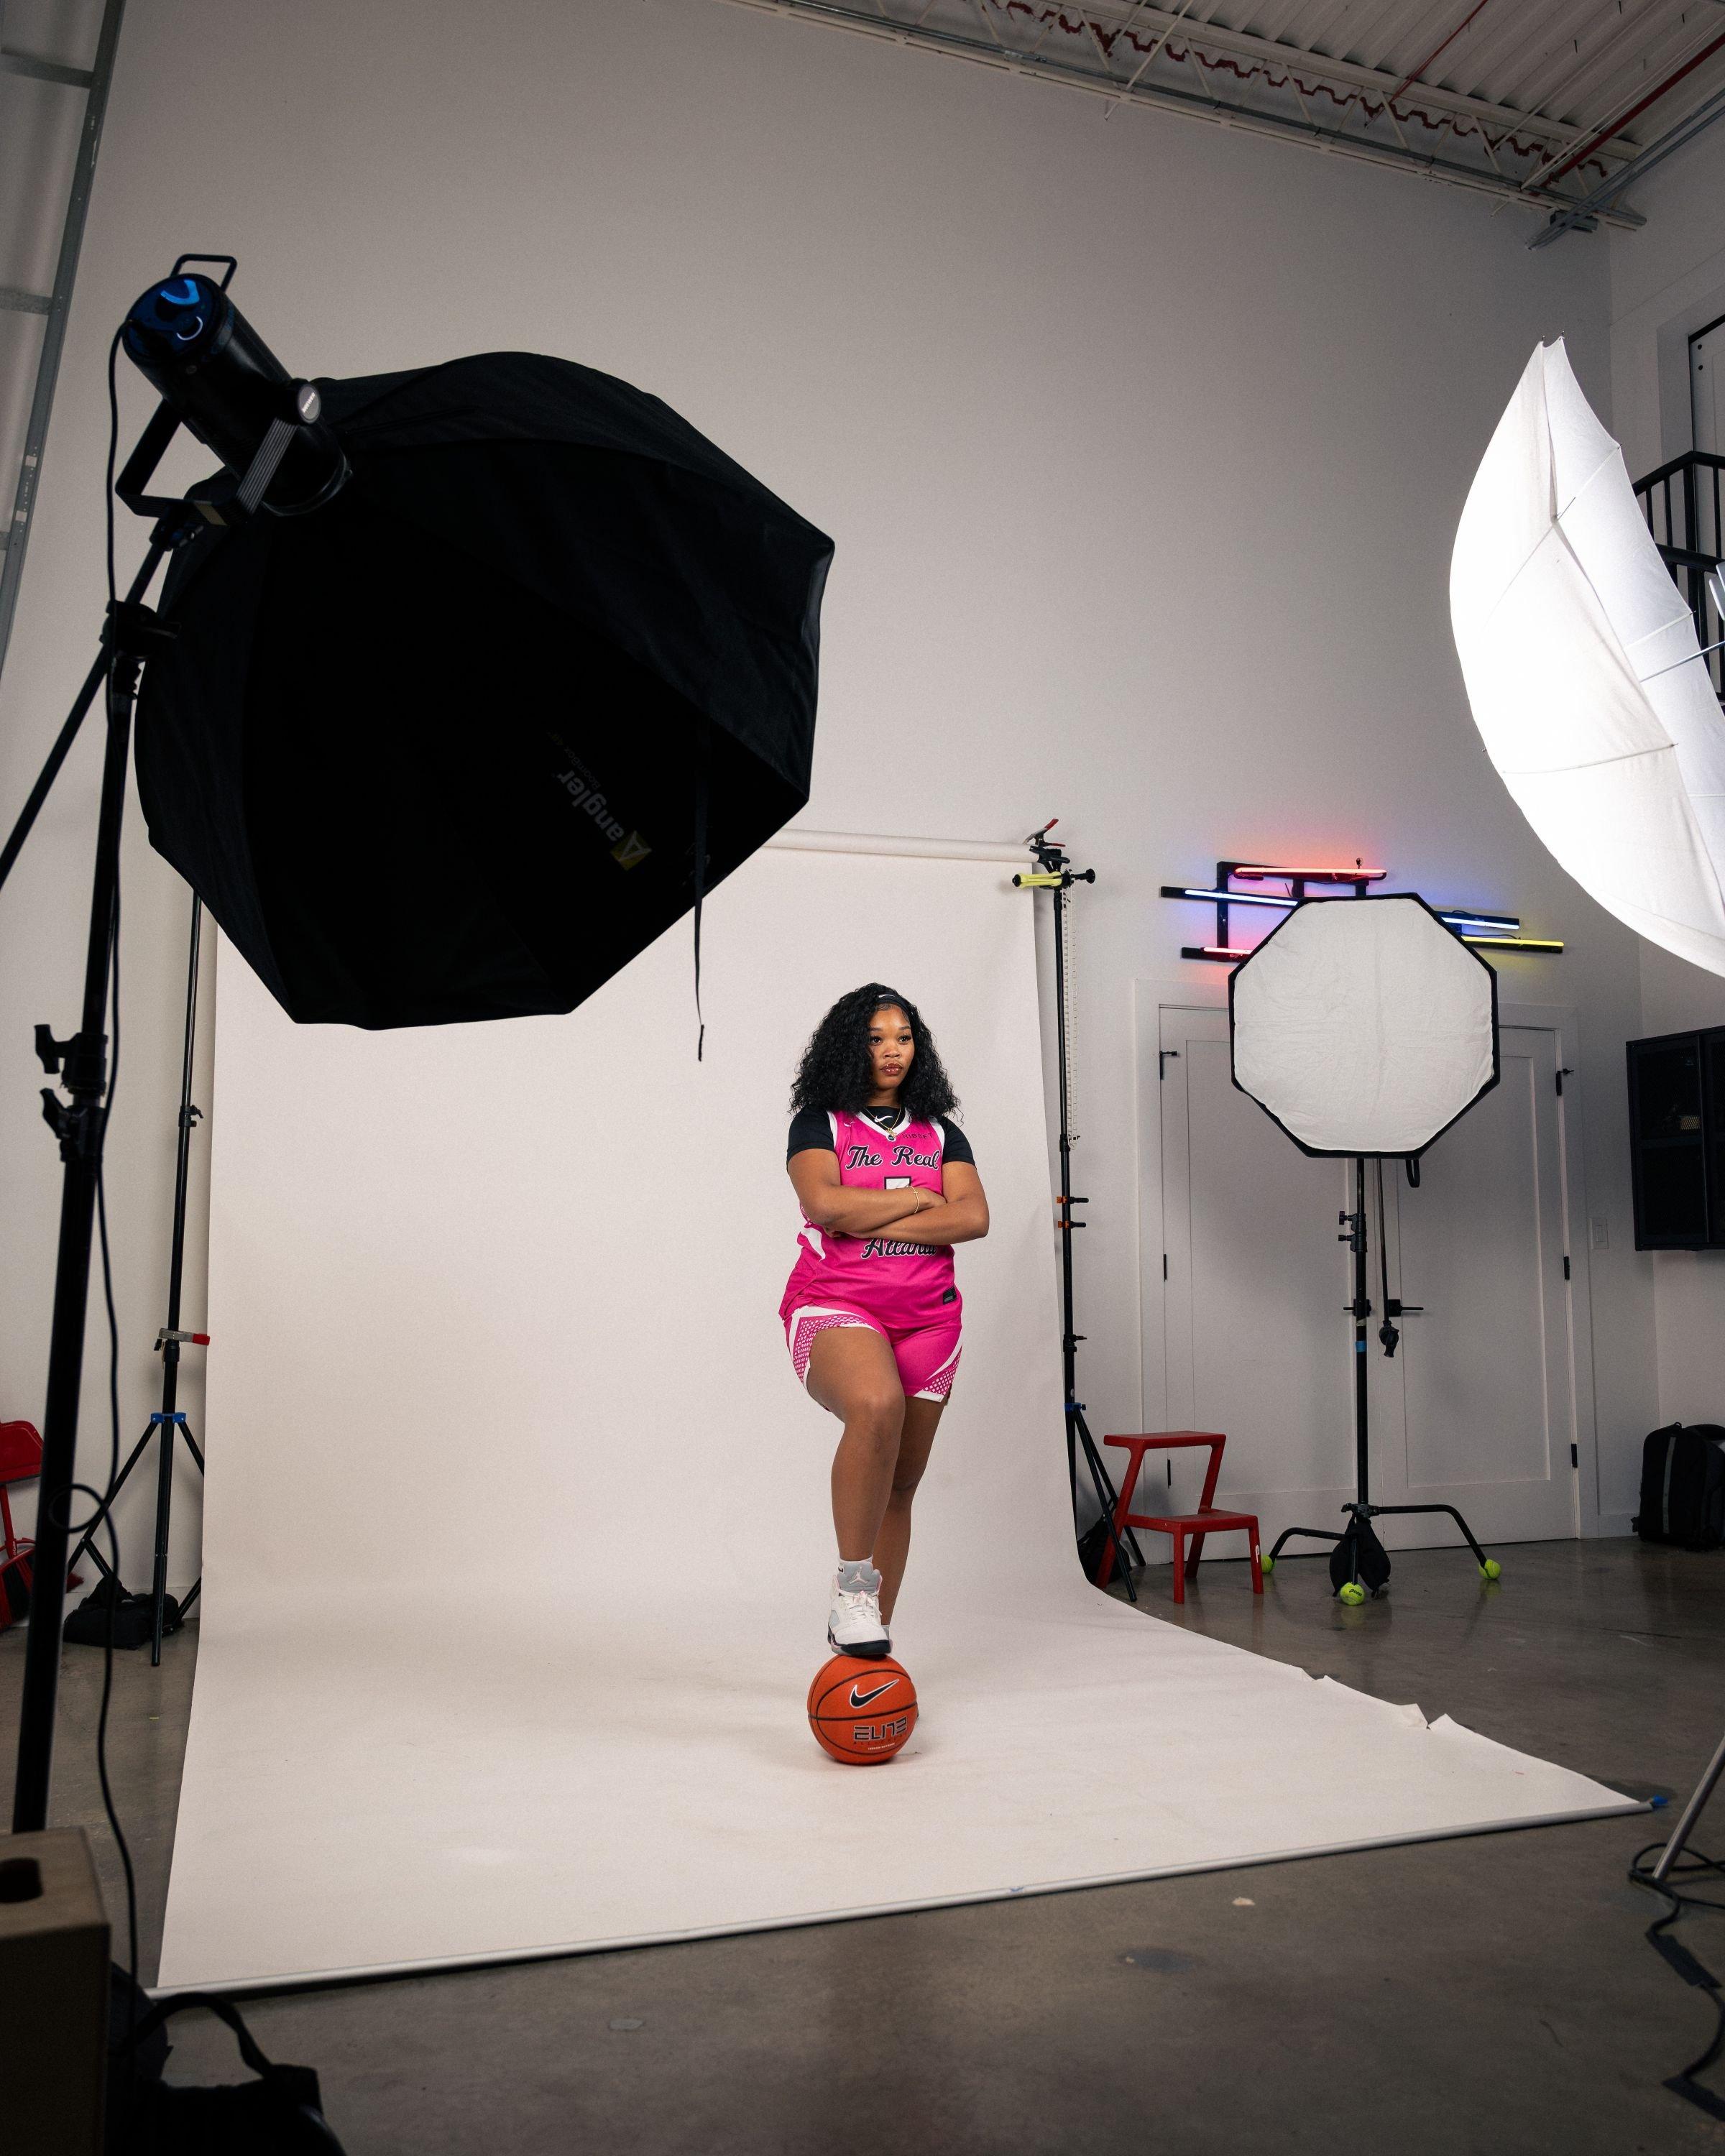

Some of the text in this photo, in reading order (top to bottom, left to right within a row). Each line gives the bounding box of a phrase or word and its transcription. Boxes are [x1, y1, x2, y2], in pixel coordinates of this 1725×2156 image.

[556, 770, 625, 842] angler
[845, 1145, 941, 1171] The Real
[853, 1715, 908, 1741] ELITE
